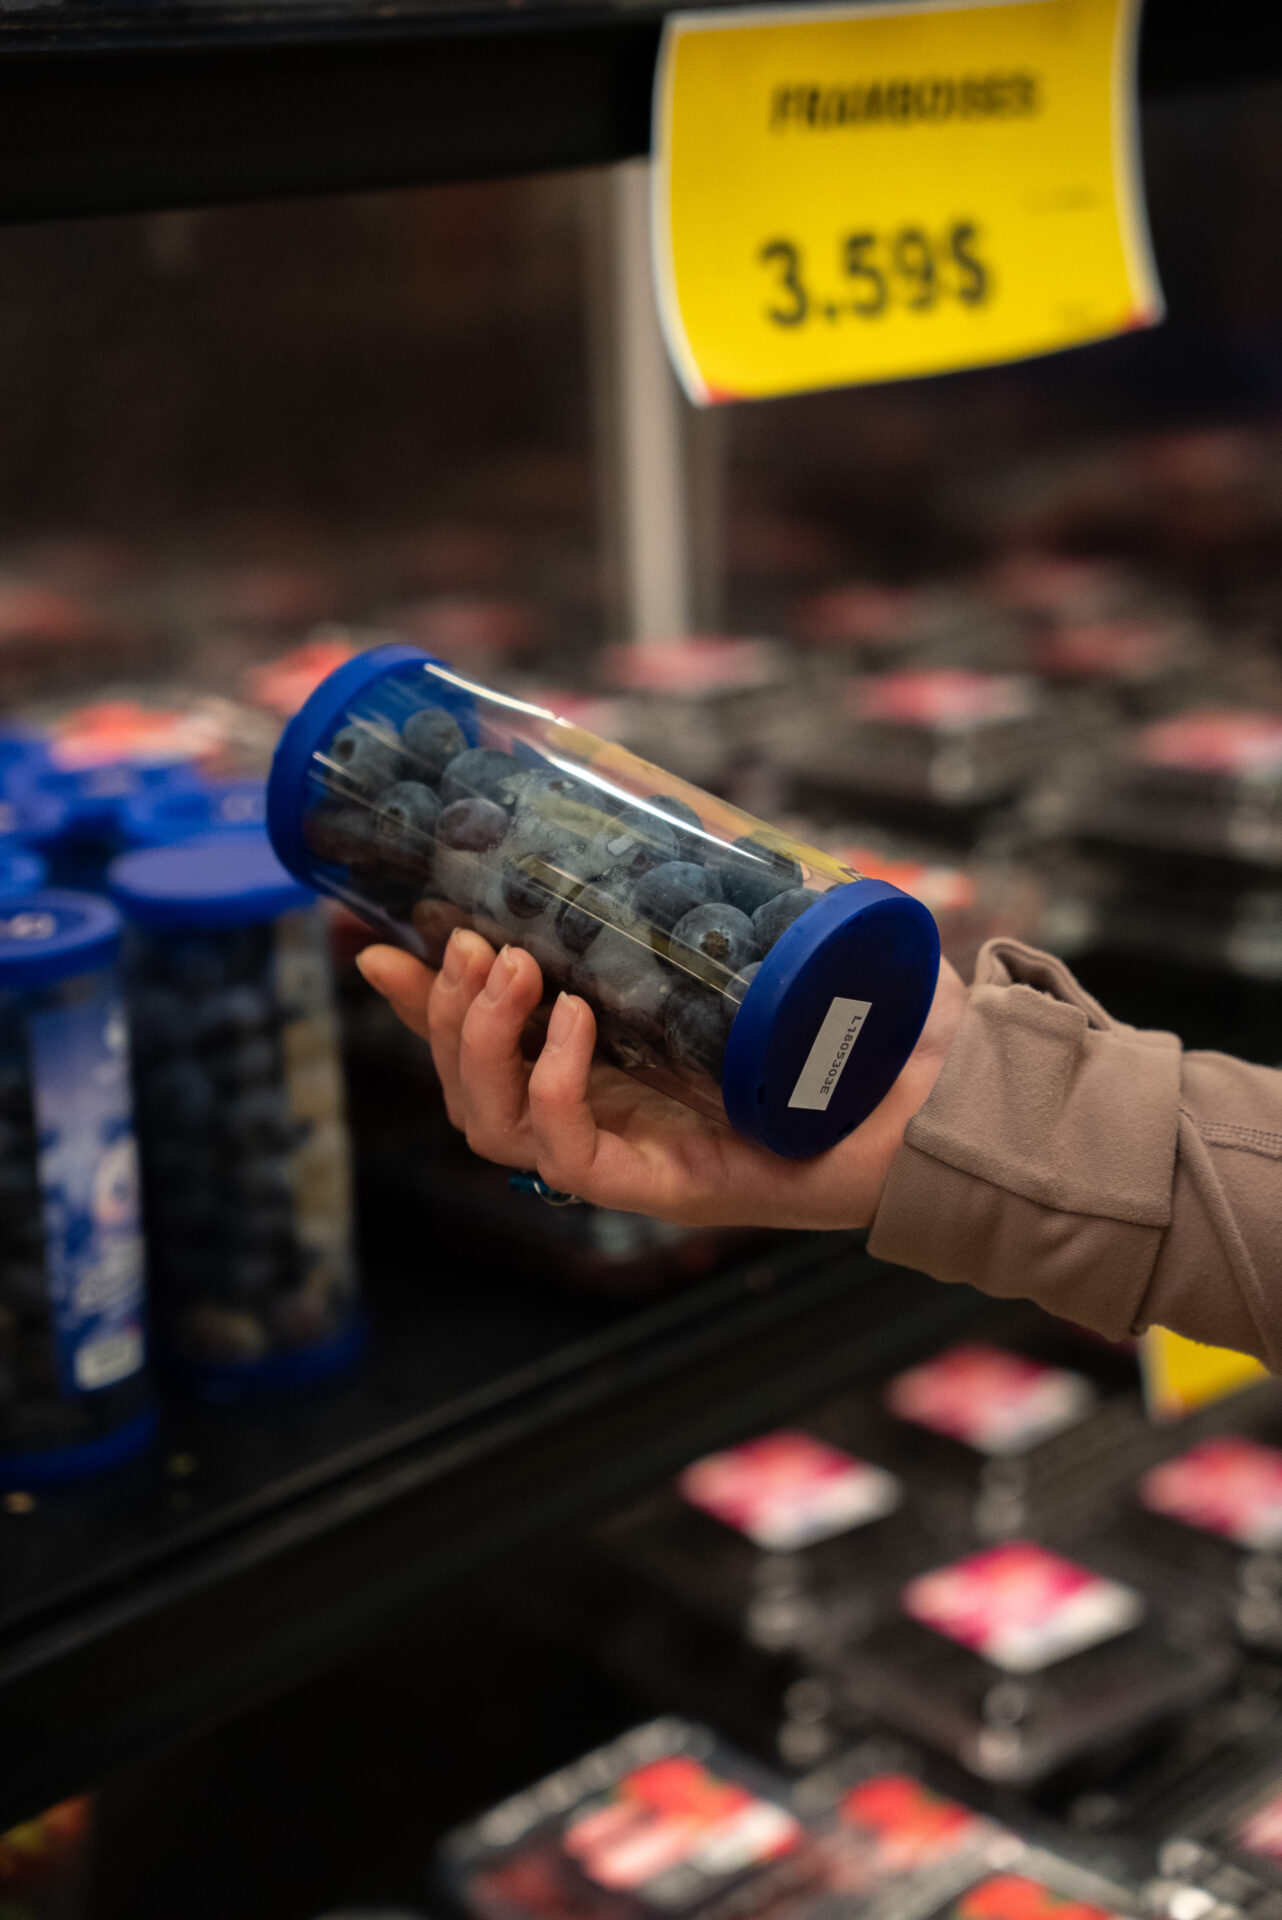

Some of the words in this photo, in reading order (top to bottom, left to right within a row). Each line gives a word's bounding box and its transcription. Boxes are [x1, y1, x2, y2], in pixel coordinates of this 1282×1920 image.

[770, 71, 1042, 132] FRAMBOISES
[758, 217, 993, 329] 3.59$
[820, 1015, 862, 1095] L1805303E
